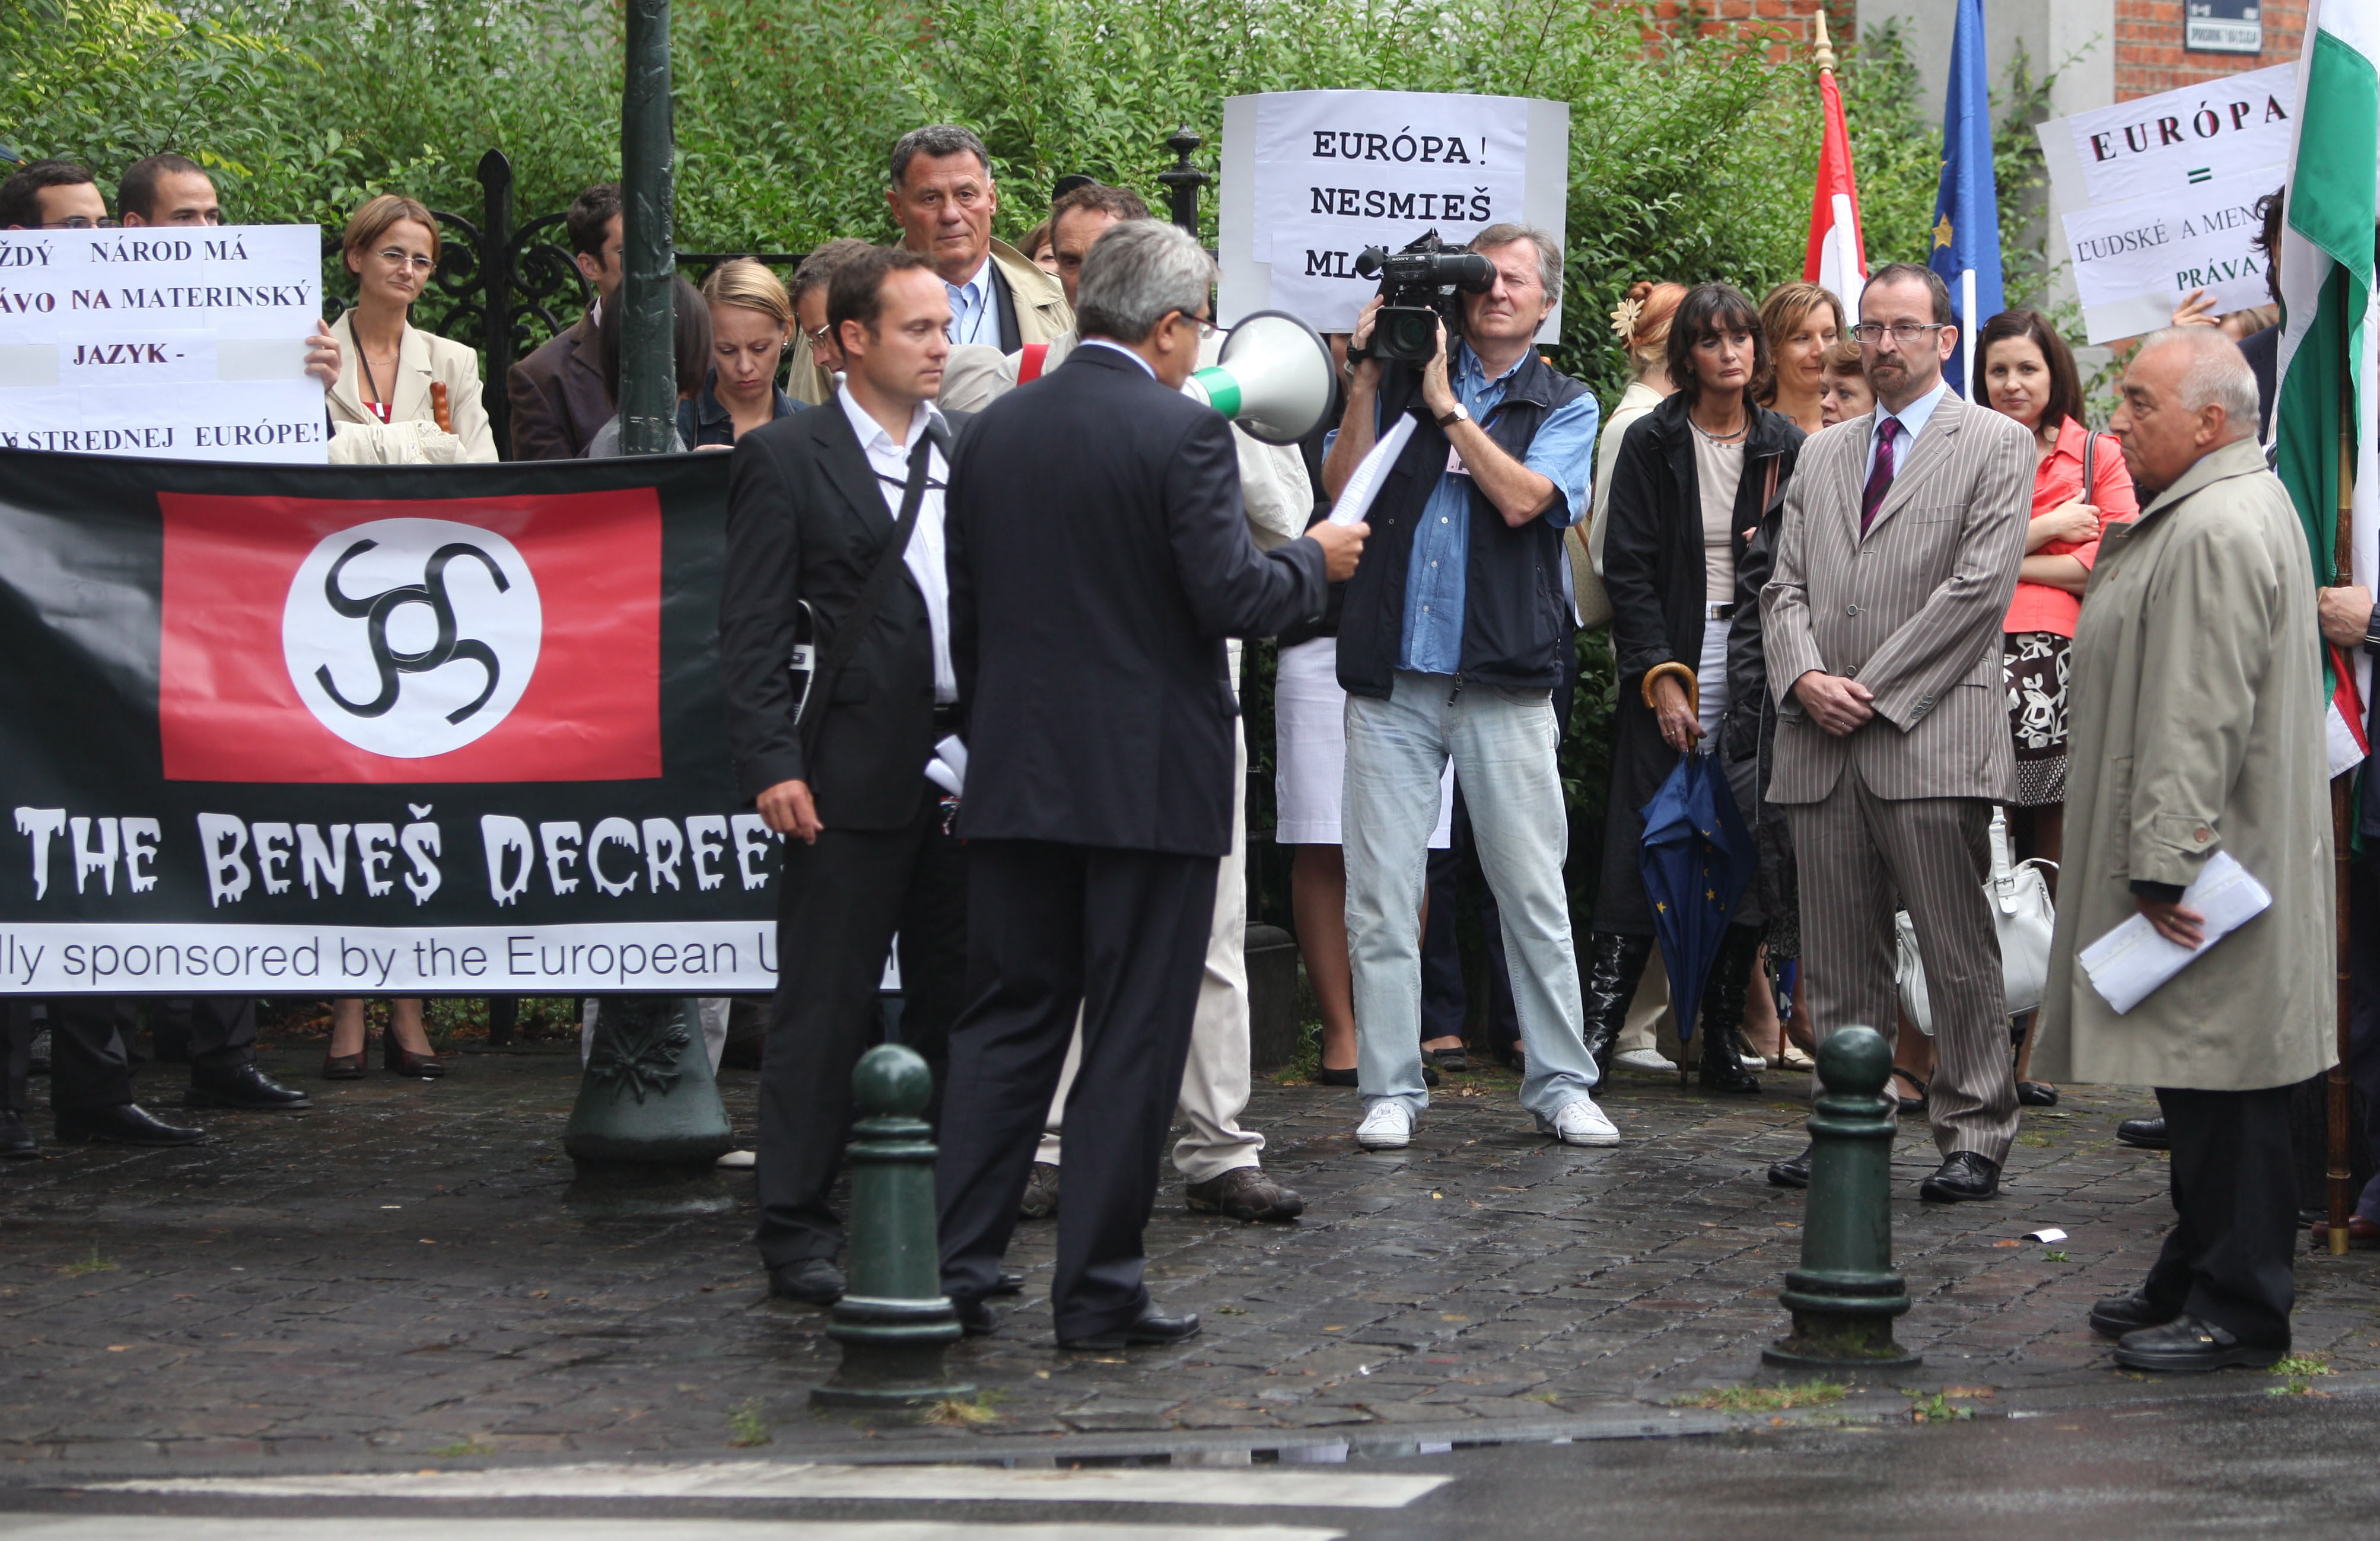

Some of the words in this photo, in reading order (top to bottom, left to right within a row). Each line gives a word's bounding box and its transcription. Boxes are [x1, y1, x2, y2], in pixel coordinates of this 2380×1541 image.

[2089, 93, 2289, 162] EURÓPA
[1310, 186, 1491, 222] NESMIEŠ
[90, 235, 192, 263] NÁROD
[203, 233, 249, 262] MÁ
[2076, 218, 2169, 262] ĽUDSKÉ
[2181, 218, 2197, 240] A
[2201, 203, 2266, 234] MEN
[2176, 256, 2260, 291] PRÁVA
[71, 289, 113, 310] NA
[121, 279, 313, 309] MATERINSKÝ
[73, 342, 169, 365] JAZYK
[28, 427, 175, 451] STREDNEJ
[195, 418, 320, 447] EURÓPE!
[14, 806, 162, 901] THE
[196, 803, 442, 909] BENEŠ
[480, 813, 785, 908] DECREE
[63, 936, 320, 985] sponsored
[341, 937, 396, 987] by
[412, 937, 487, 976] the
[508, 935, 738, 985] European
